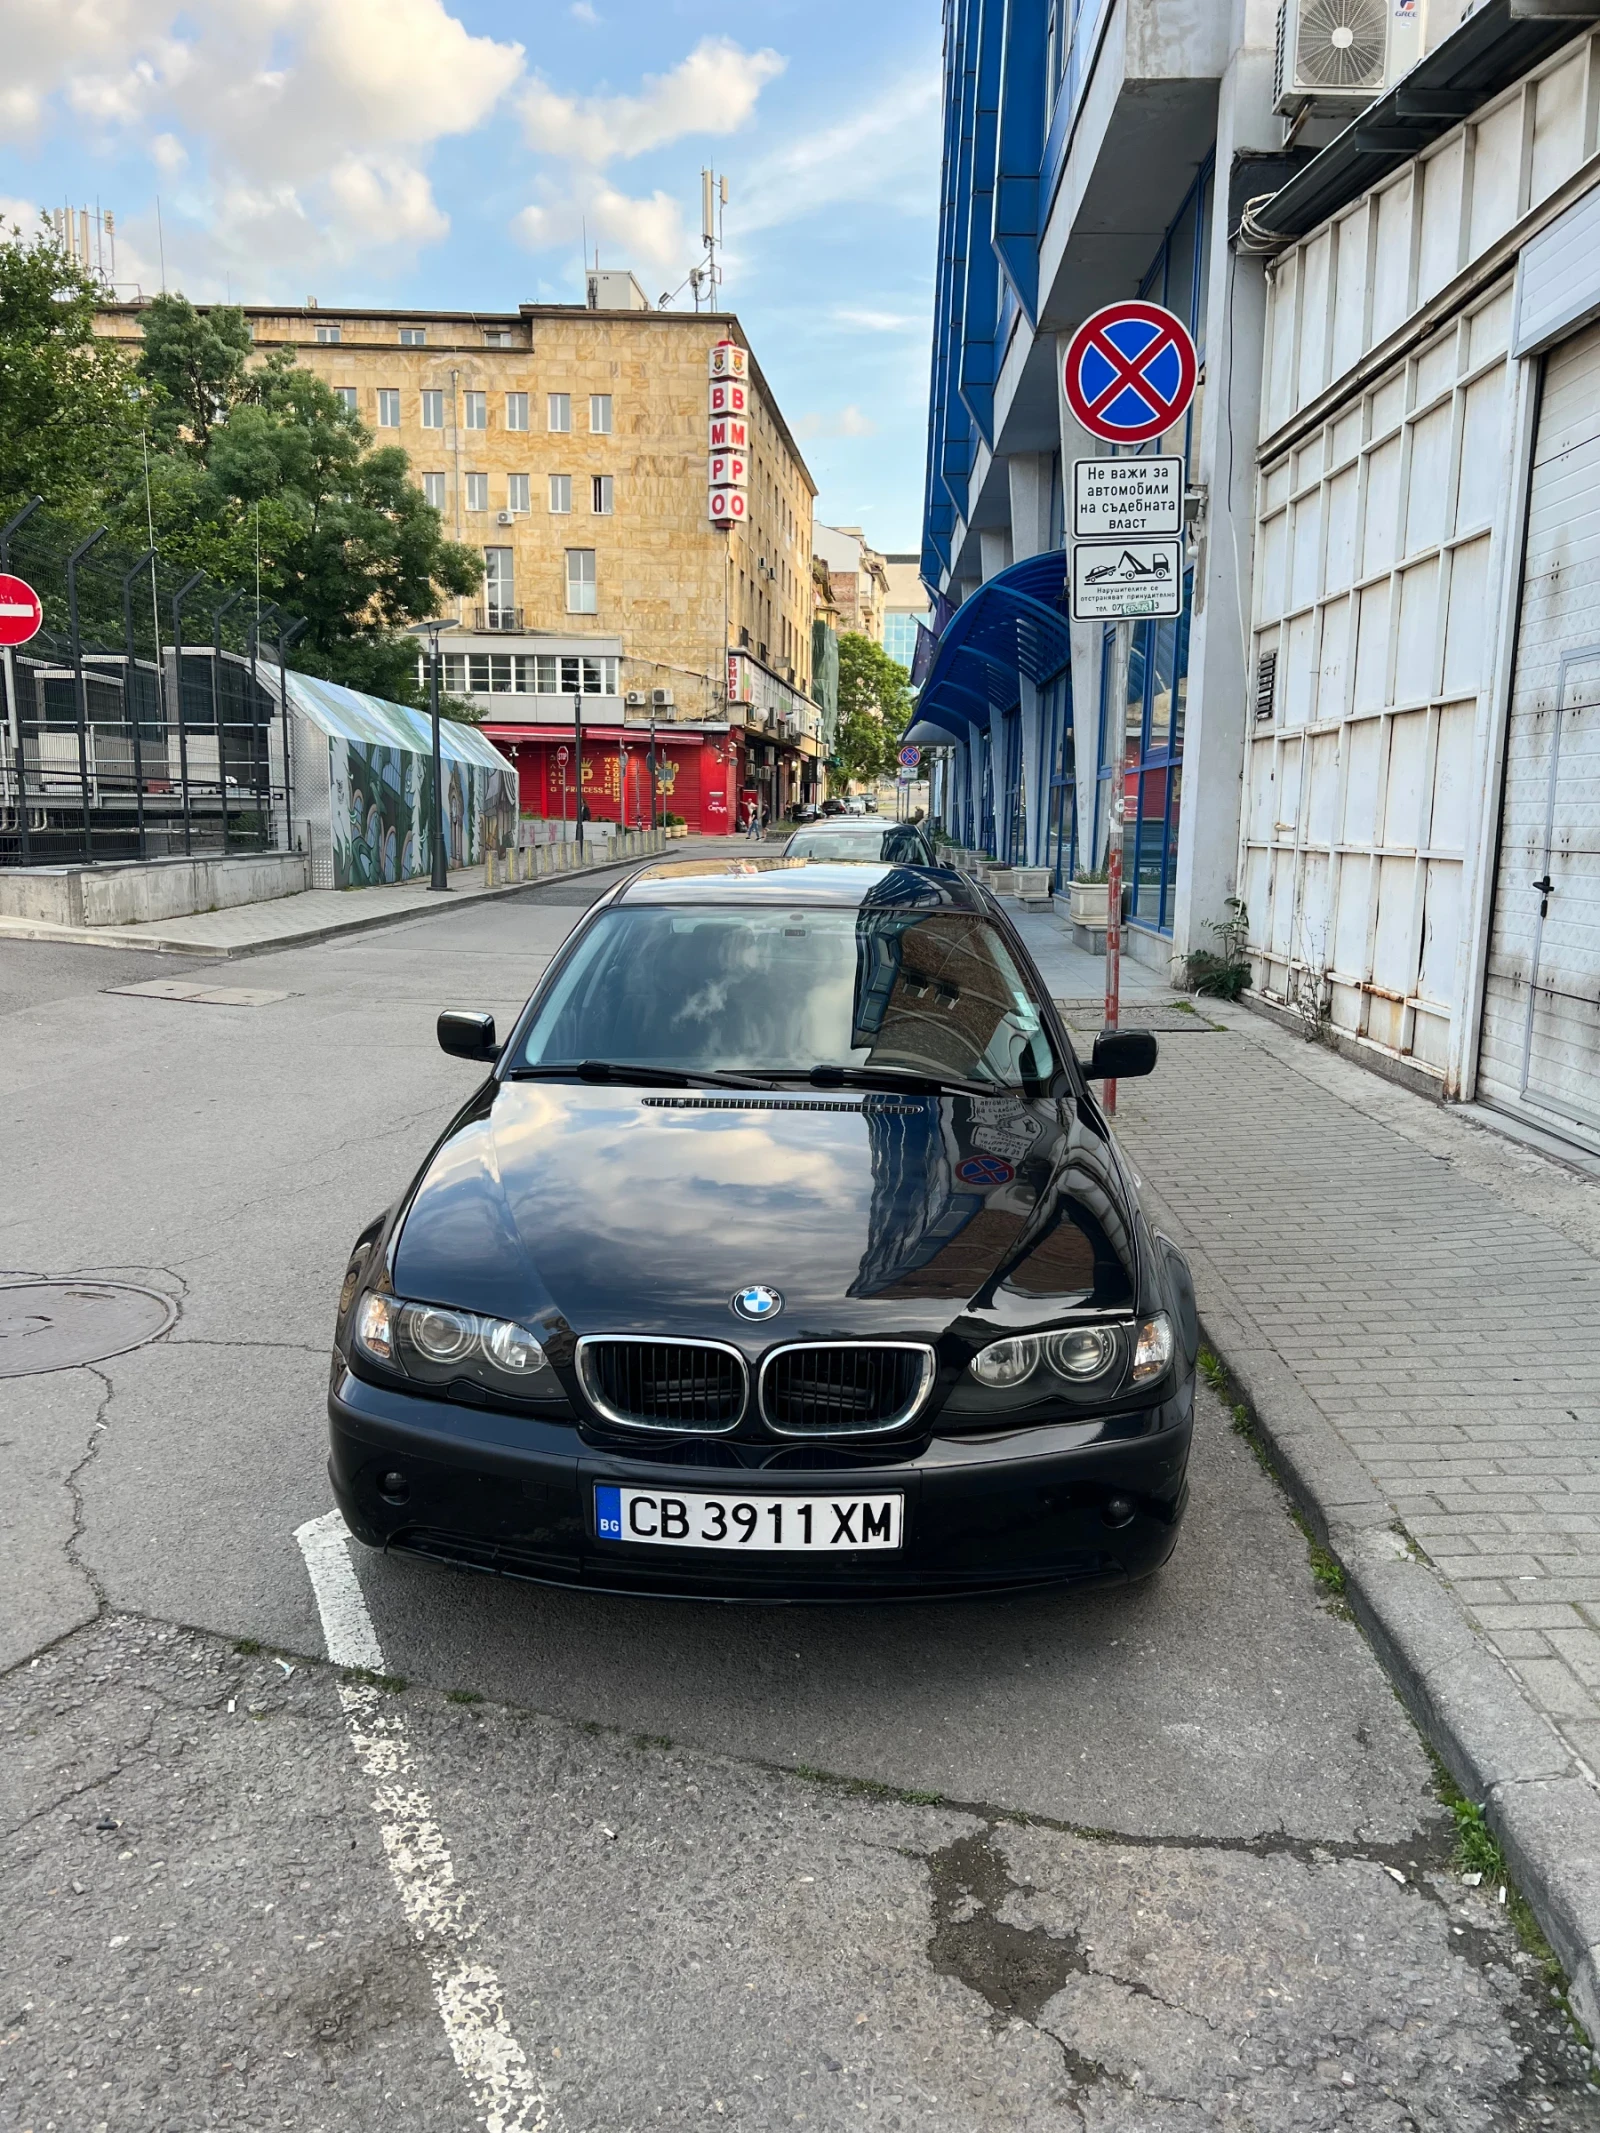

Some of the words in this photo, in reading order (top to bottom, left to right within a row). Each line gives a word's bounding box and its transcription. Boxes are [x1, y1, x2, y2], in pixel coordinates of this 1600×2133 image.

[712, 388, 725, 515] ВМРО
[731, 388, 745, 516] ВМРО
[1088, 467, 1105, 480] Не
[1111, 468, 1147, 479] важи
[1153, 467, 1169, 478] за
[1087, 482, 1169, 497] автомобили
[1080, 504, 1096, 514] на
[1102, 499, 1176, 514] съдебната
[1109, 518, 1147, 530] власт
[1097, 586, 1148, 595] Нарушителите
[1080, 594, 1123, 603] отстраняват
[1126, 592, 1175, 601] принудително
[558, 752, 567, 760] STOP
[740, 1286, 778, 1297] BMW
[600, 1518, 620, 1533] BG
[701, 1501, 812, 1544] 3911
